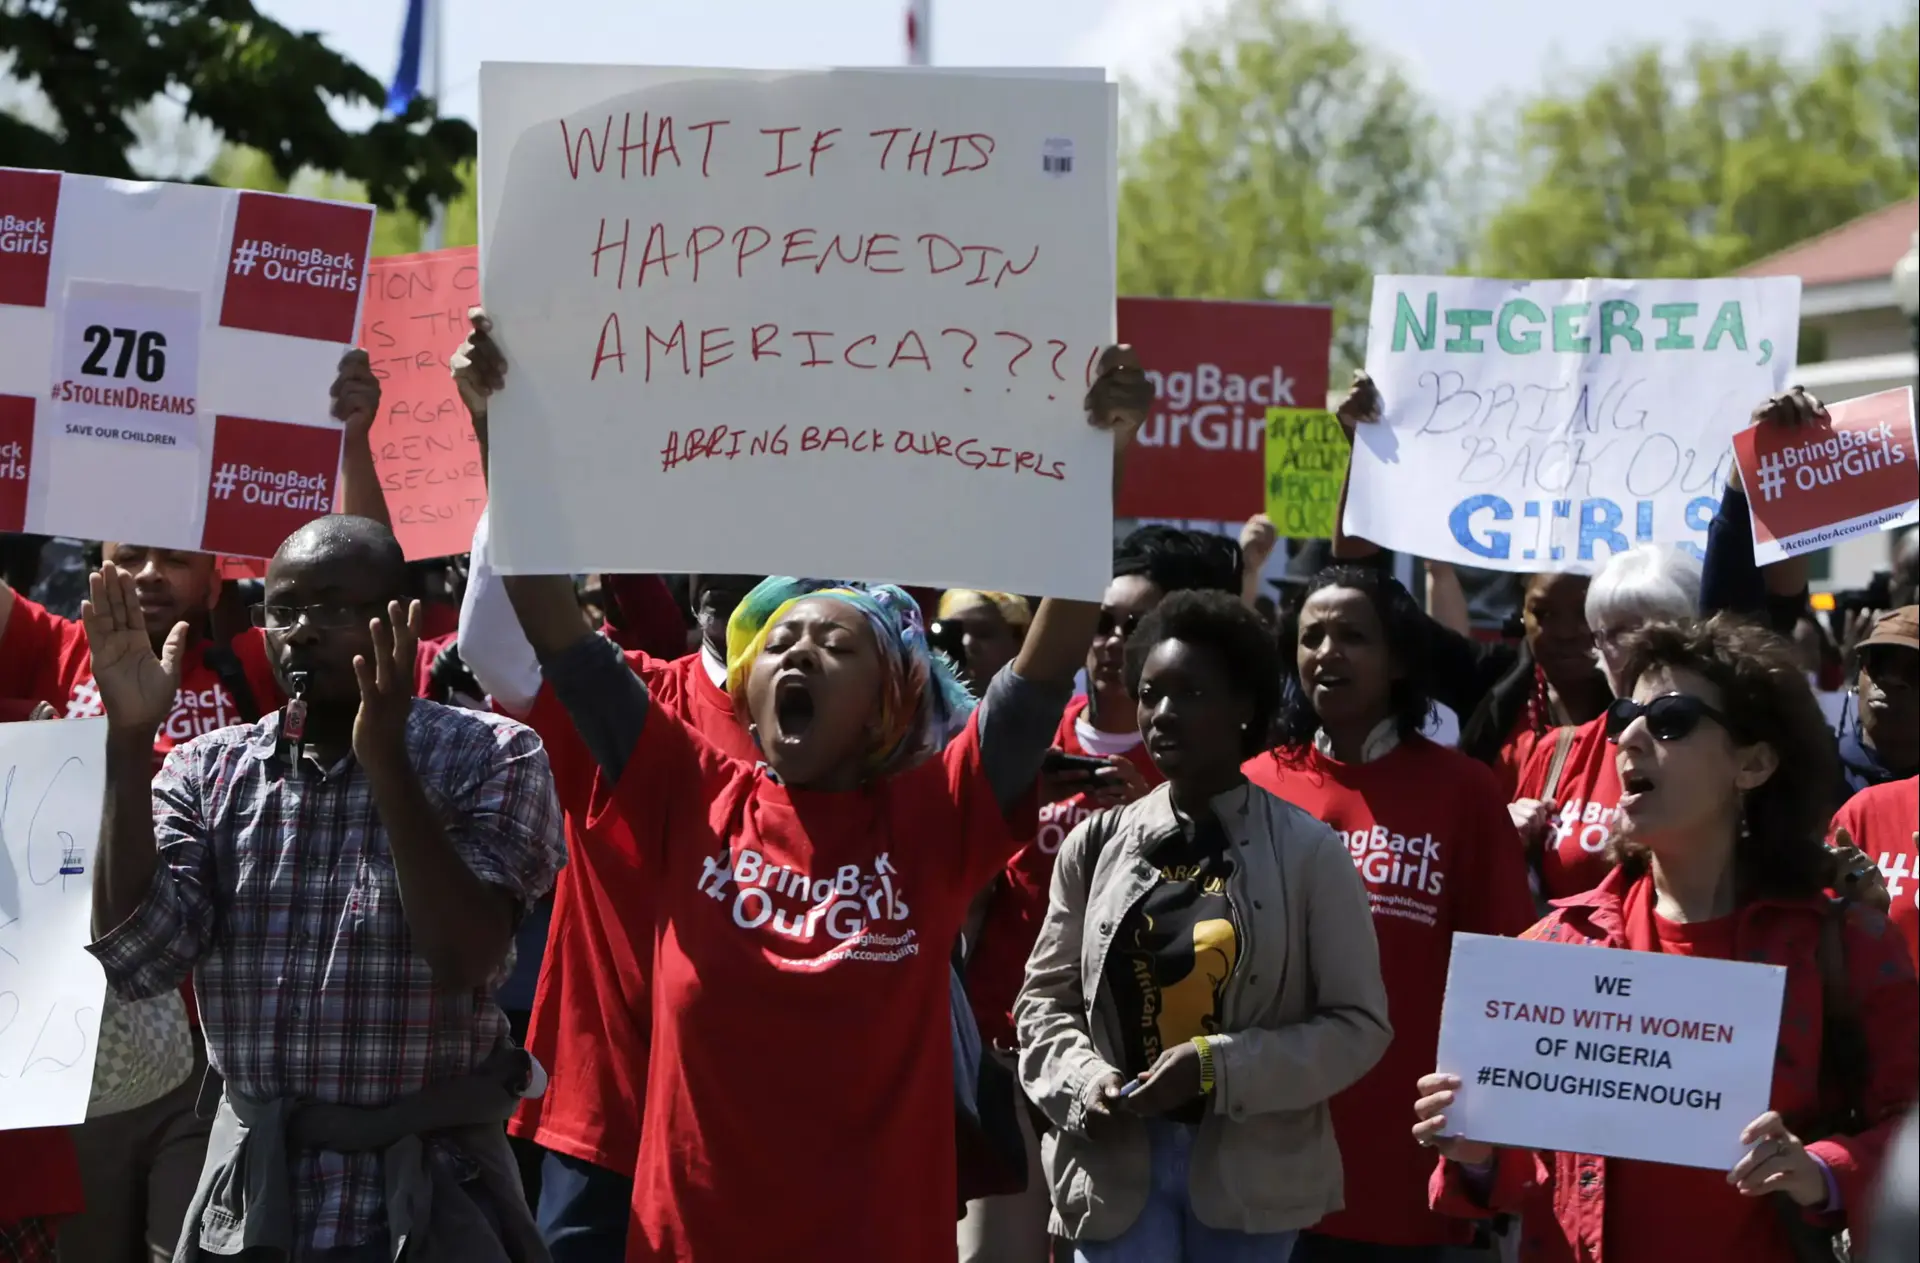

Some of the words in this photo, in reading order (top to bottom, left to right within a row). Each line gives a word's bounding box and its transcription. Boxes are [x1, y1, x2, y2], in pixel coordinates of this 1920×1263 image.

[560, 111, 730, 180] WHAT
[759, 127, 842, 176] IF
[869, 128, 996, 177] THIS
[0, 215, 46, 233] Back
[233, 239, 355, 276] #BringBack
[263, 260, 357, 292] OurGirls
[409, 304, 481, 337] TH
[1390, 291, 1775, 367] NIGERIA,
[81, 324, 168, 383] 276
[1415, 370, 1649, 442] BRING
[65, 424, 92, 437] SAVE
[95, 427, 119, 439] OUR
[121, 430, 177, 446] CHILDREN
[212, 463, 328, 500] #BringBack
[1458, 434, 1618, 498] BACK
[1625, 432, 1732, 498] OU
[1757, 420, 1895, 502] #BringBack
[1795, 441, 1906, 491] OurGirls
[242, 483, 330, 512] OurGirls
[1132, 957, 1157, 1028] African
[1594, 975, 1633, 997] WE
[1484, 999, 1566, 1026] STAND
[1573, 1008, 1633, 1034] WITH
[1640, 1016, 1734, 1044] WOMEN
[1534, 1036, 1568, 1058] OF
[1575, 1042, 1673, 1069] NIGERIA
[1476, 1066, 1722, 1111] #ENOUGHISENOUGH
